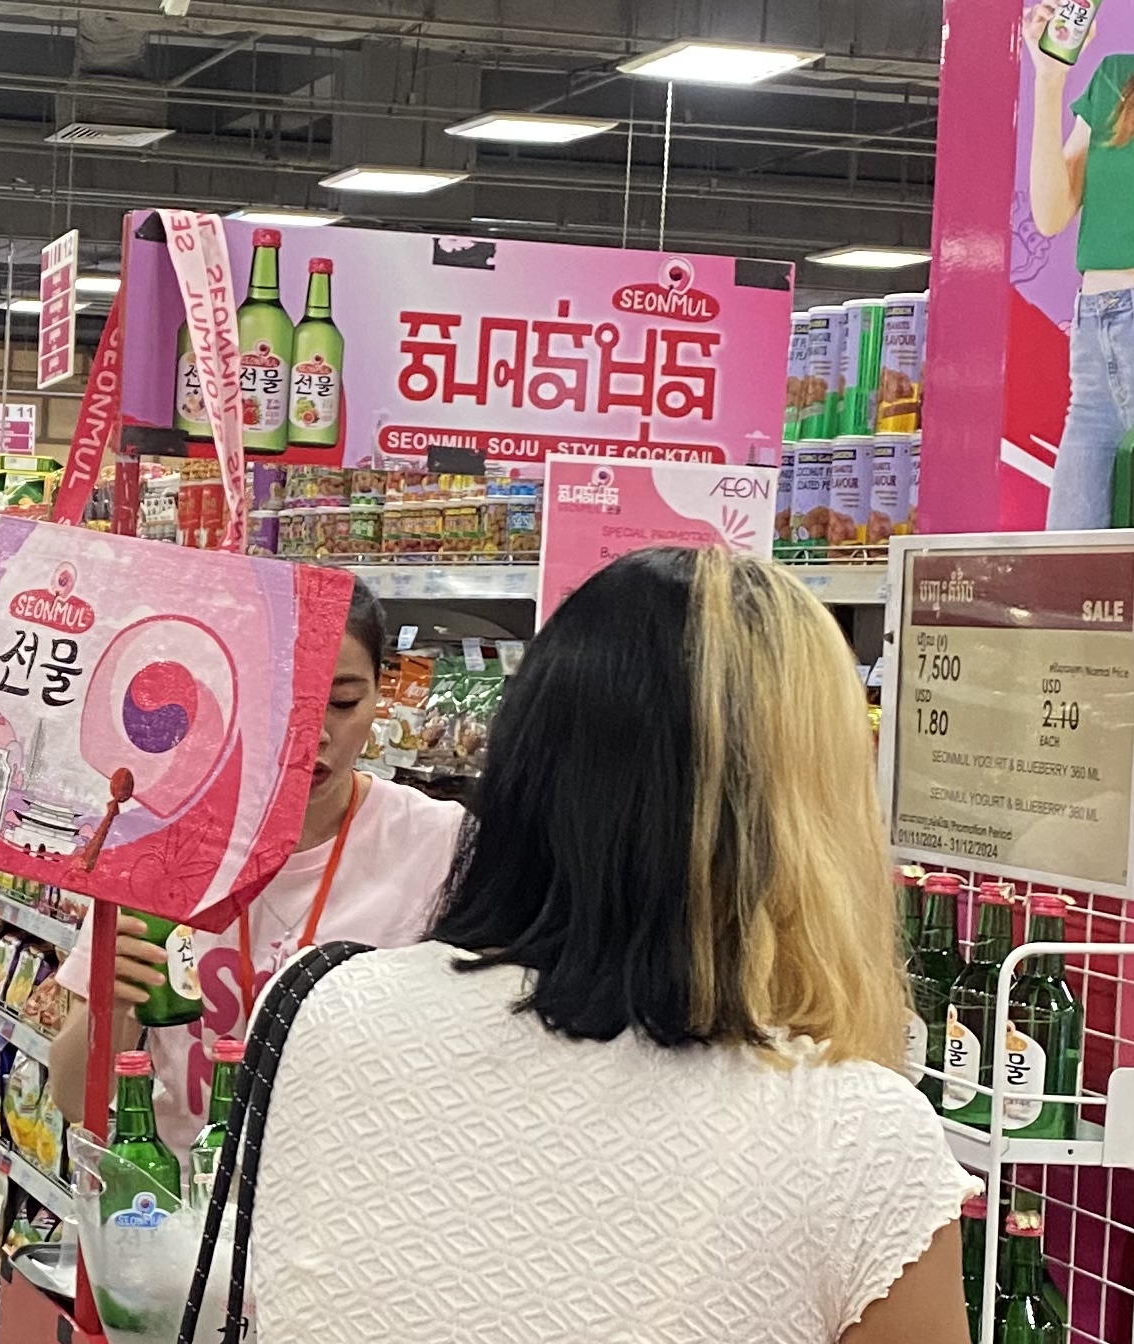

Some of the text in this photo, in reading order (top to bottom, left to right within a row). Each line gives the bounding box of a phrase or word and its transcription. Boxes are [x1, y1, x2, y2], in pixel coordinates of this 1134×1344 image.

[620, 287, 713, 320] SEONMUL
[17, 406, 33, 418] 11
[487, 437, 539, 457] SOJU
[601, 525, 648, 539] SPECIAL
[15, 593, 88, 629] SEONMUL
[1082, 599, 1124, 623] SALE
[918, 654, 961, 683] 7,500
[915, 688, 933, 703] USD
[1042, 678, 1061, 694] USD
[916, 708, 949, 736] 1.80
[1042, 700, 1079, 730] 2.10
[1039, 735, 1061, 748] EACH
[972, 754, 1008, 770] YOGURT
[1016, 759, 1068, 777] BLUEBERRY
[969, 792, 1006, 808] YOGURT
[1014, 798, 1067, 816] BLUEBERRY
[988, 825, 1013, 841] Period
[949, 837, 999, 858] 31/12/2024
